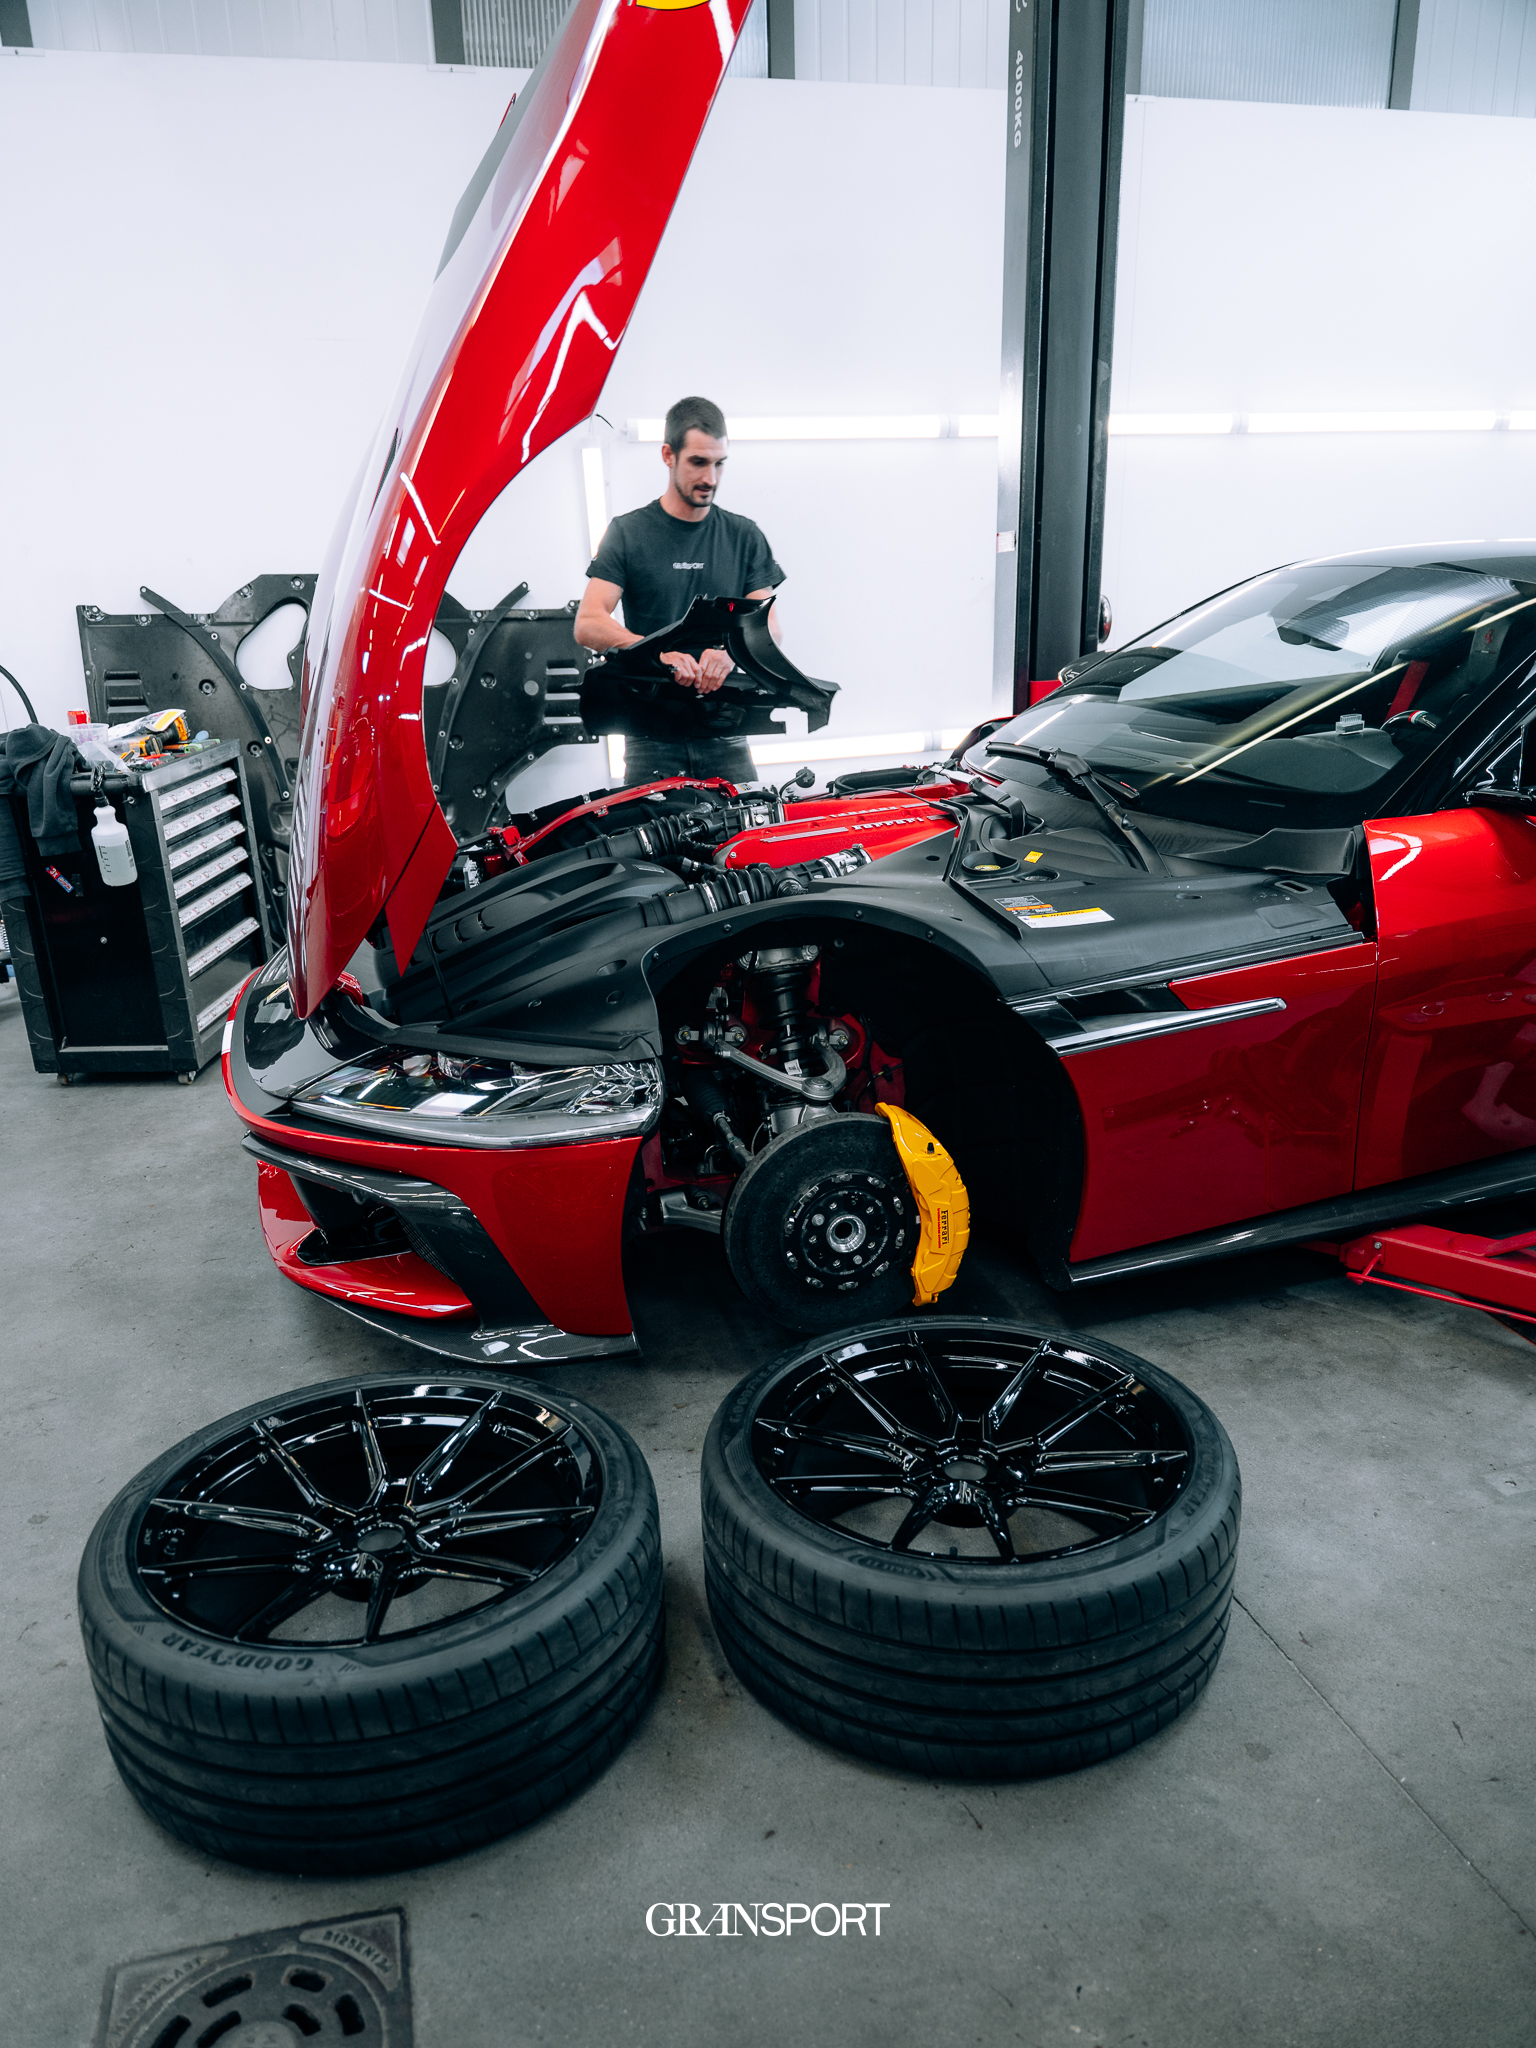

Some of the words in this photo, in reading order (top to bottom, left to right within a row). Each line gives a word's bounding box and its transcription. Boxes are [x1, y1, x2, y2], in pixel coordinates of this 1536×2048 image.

[1013, 49, 1024, 148] 4000KG
[941, 1209, 950, 1245] Ferrari
[161, 1631, 314, 1672] GOODYEAR
